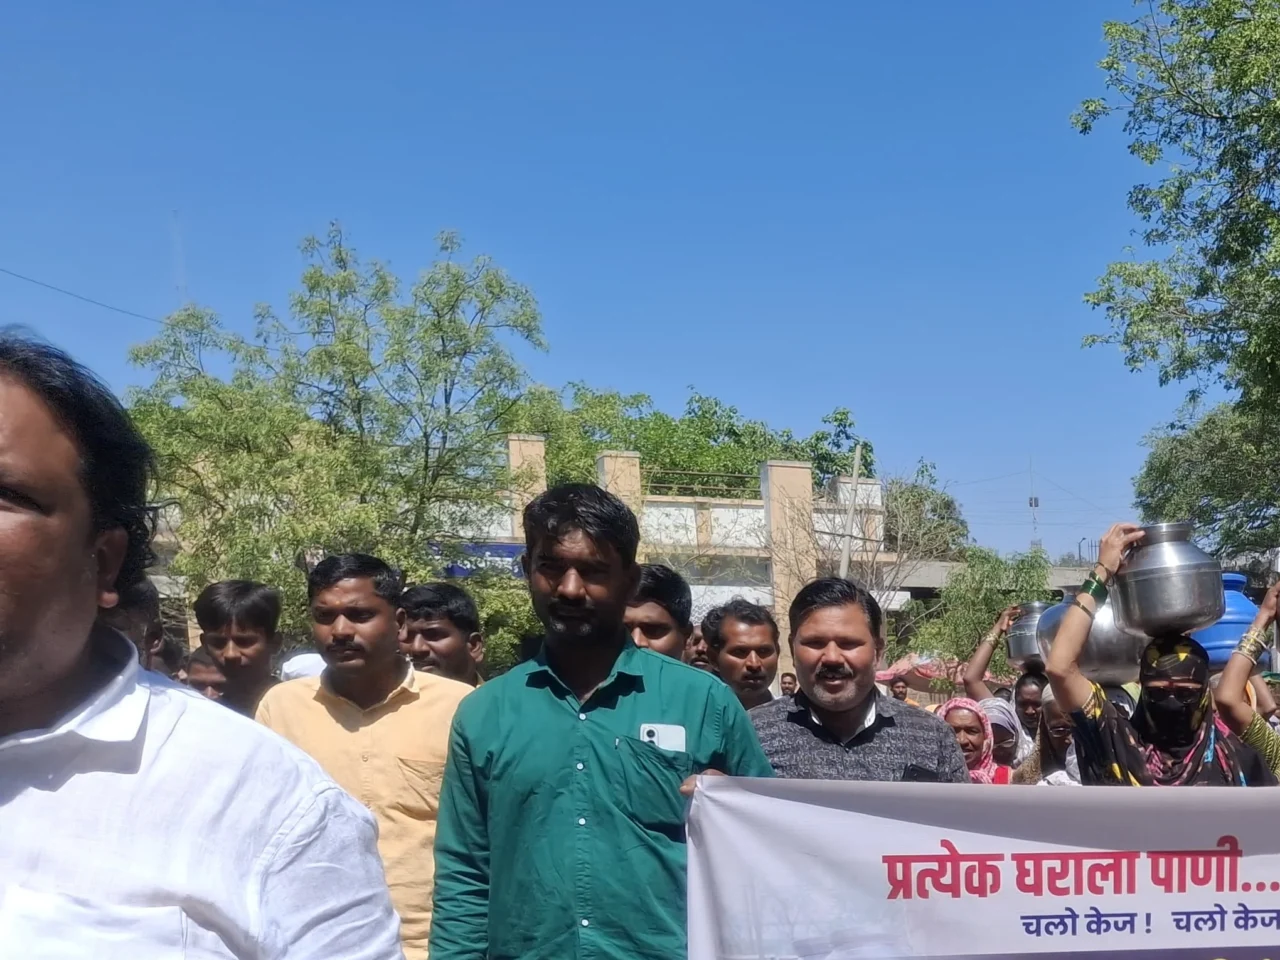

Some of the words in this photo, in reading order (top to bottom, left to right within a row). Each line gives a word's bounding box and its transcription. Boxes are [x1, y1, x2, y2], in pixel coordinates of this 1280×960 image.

[882, 839, 1004, 899] प्रत्येक
[1011, 851, 1140, 897] घराला
[1020, 907, 1079, 937] चलो
[1084, 907, 1138, 935] केज
[1171, 903, 1228, 932] चलो
